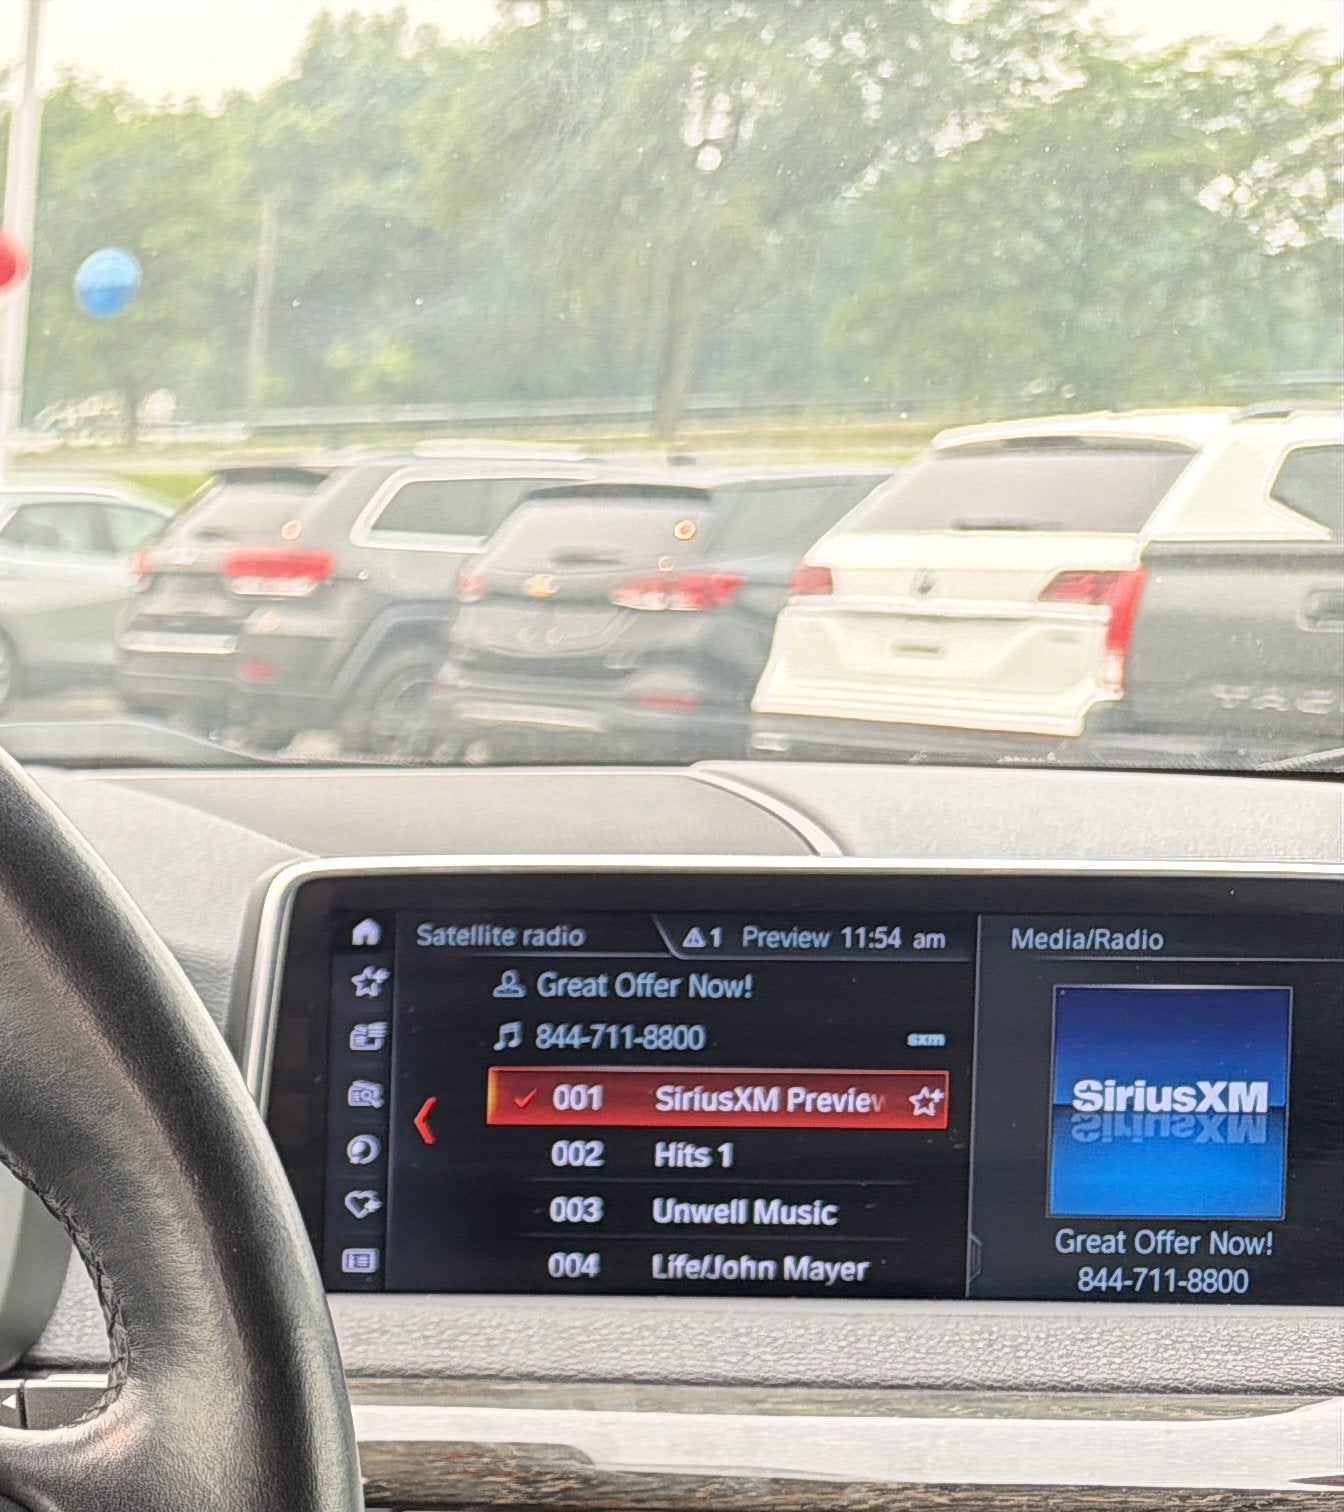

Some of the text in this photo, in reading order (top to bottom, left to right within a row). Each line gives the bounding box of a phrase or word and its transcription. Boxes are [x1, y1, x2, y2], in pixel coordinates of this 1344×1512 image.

[416, 922, 586, 949] Satellite radio
[710, 925, 946, 949] 1 Preview 11:54 am
[1011, 927, 1164, 952] Media/Radio
[537, 972, 754, 999] Great Offer Now!
[535, 1024, 706, 1052] 844-711-8800
[552, 1085, 604, 1111] 001
[655, 1085, 779, 1112] SiriusXM
[1072, 1079, 1269, 1113] SiriusXM
[550, 1141, 733, 1168] 002 Hits 1
[549, 1197, 840, 1226] 003 Unwell Music
[1054, 1229, 1273, 1256] Great Offer Now!
[547, 1253, 872, 1287] 004 Life/John Mayer
[1077, 1266, 1250, 1295] 844-711-8800
